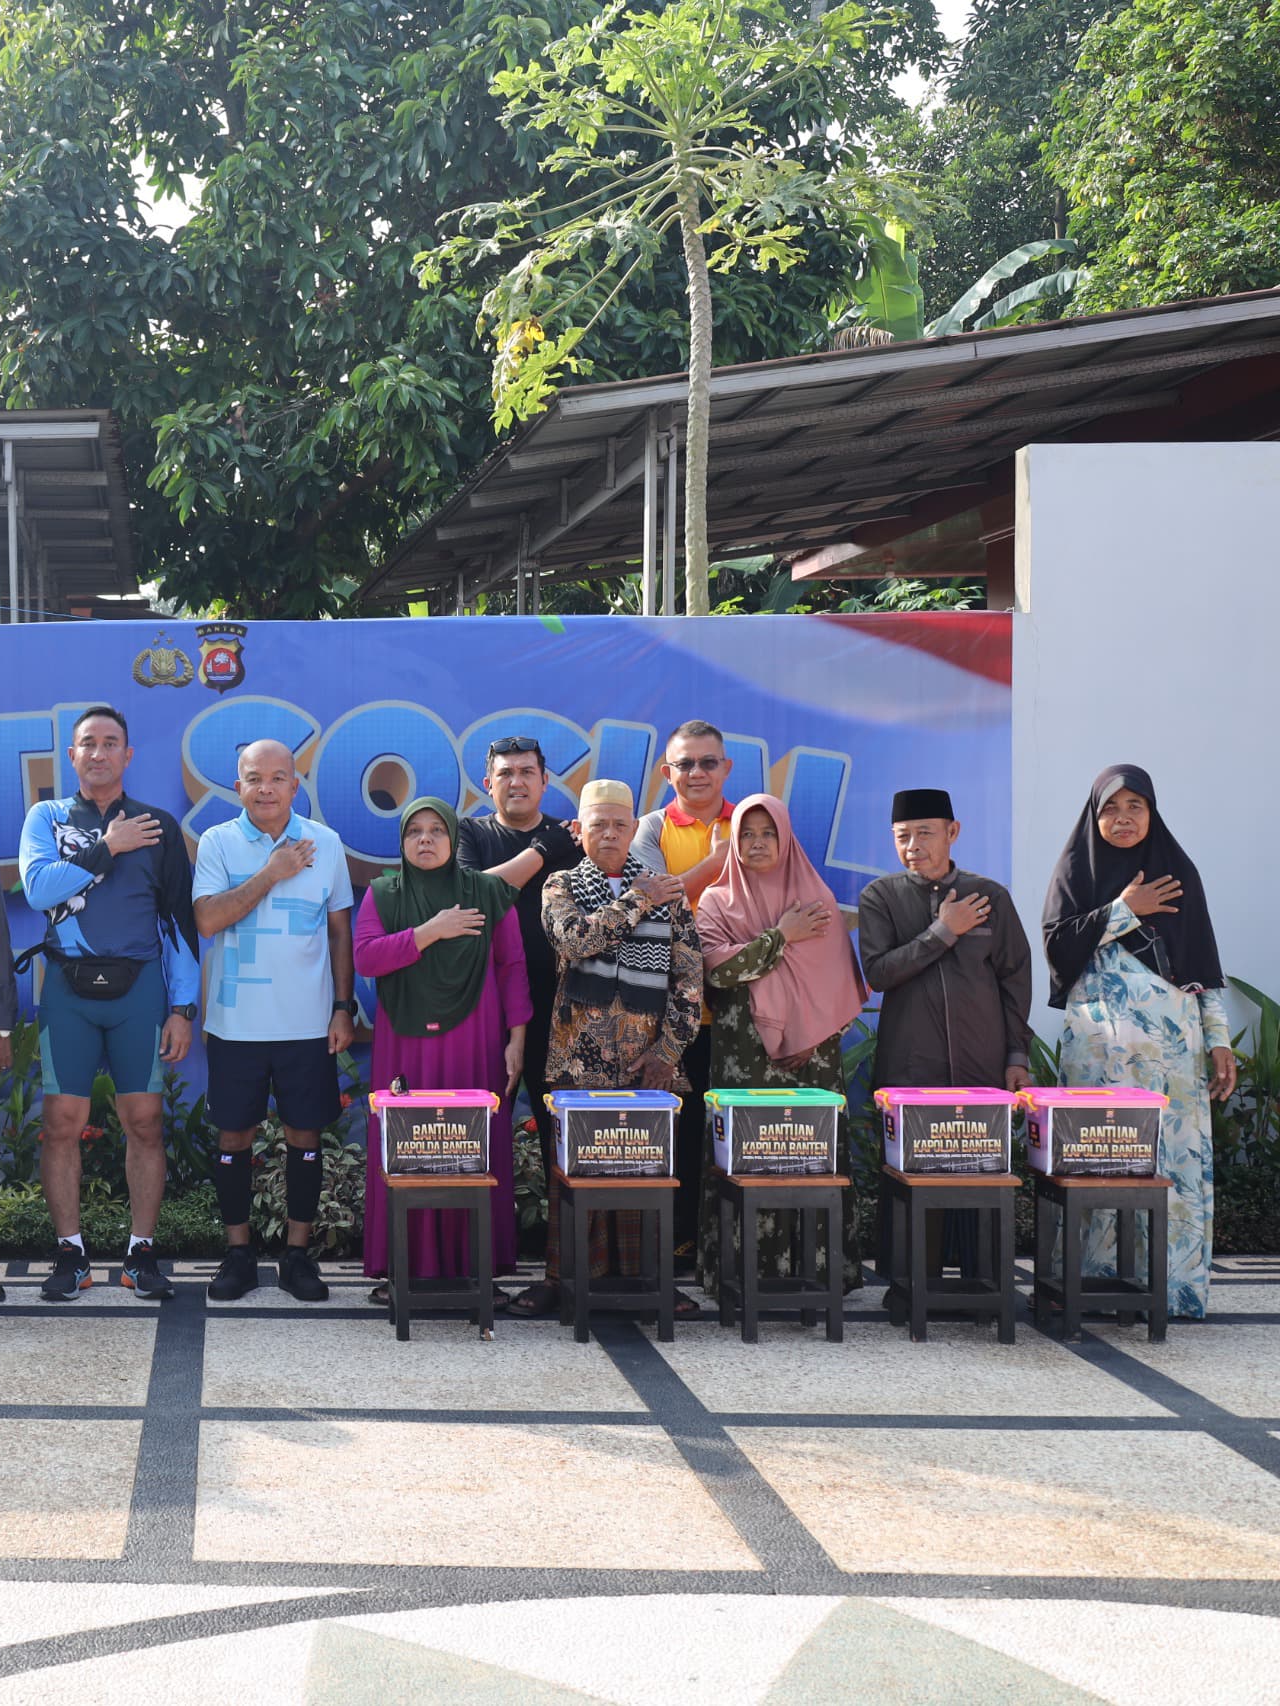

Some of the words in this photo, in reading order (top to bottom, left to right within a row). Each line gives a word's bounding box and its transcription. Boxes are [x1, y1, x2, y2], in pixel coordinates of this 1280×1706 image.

[198, 624, 244, 635] BANTEN
[412, 1123, 467, 1141] BANTUAN
[594, 1128, 649, 1146] BANTUAN
[759, 1123, 814, 1142] BANTUAN
[930, 1121, 987, 1139] BANTUAN
[1080, 1125, 1138, 1144] BANTUAN
[396, 1141, 440, 1154] KAPOLDA
[442, 1141, 481, 1154] BANTEN
[578, 1145, 622, 1159] KAPOLDA
[624, 1146, 663, 1160] BANTEN
[742, 1141, 787, 1155] KAPOLDA
[789, 1142, 828, 1155] BANTEN
[913, 1139, 959, 1153] KAPOLDA
[961, 1139, 1001, 1153] BANTEN
[1063, 1143, 1109, 1158] KAPOLDA
[1111, 1143, 1152, 1158] BANTEN
